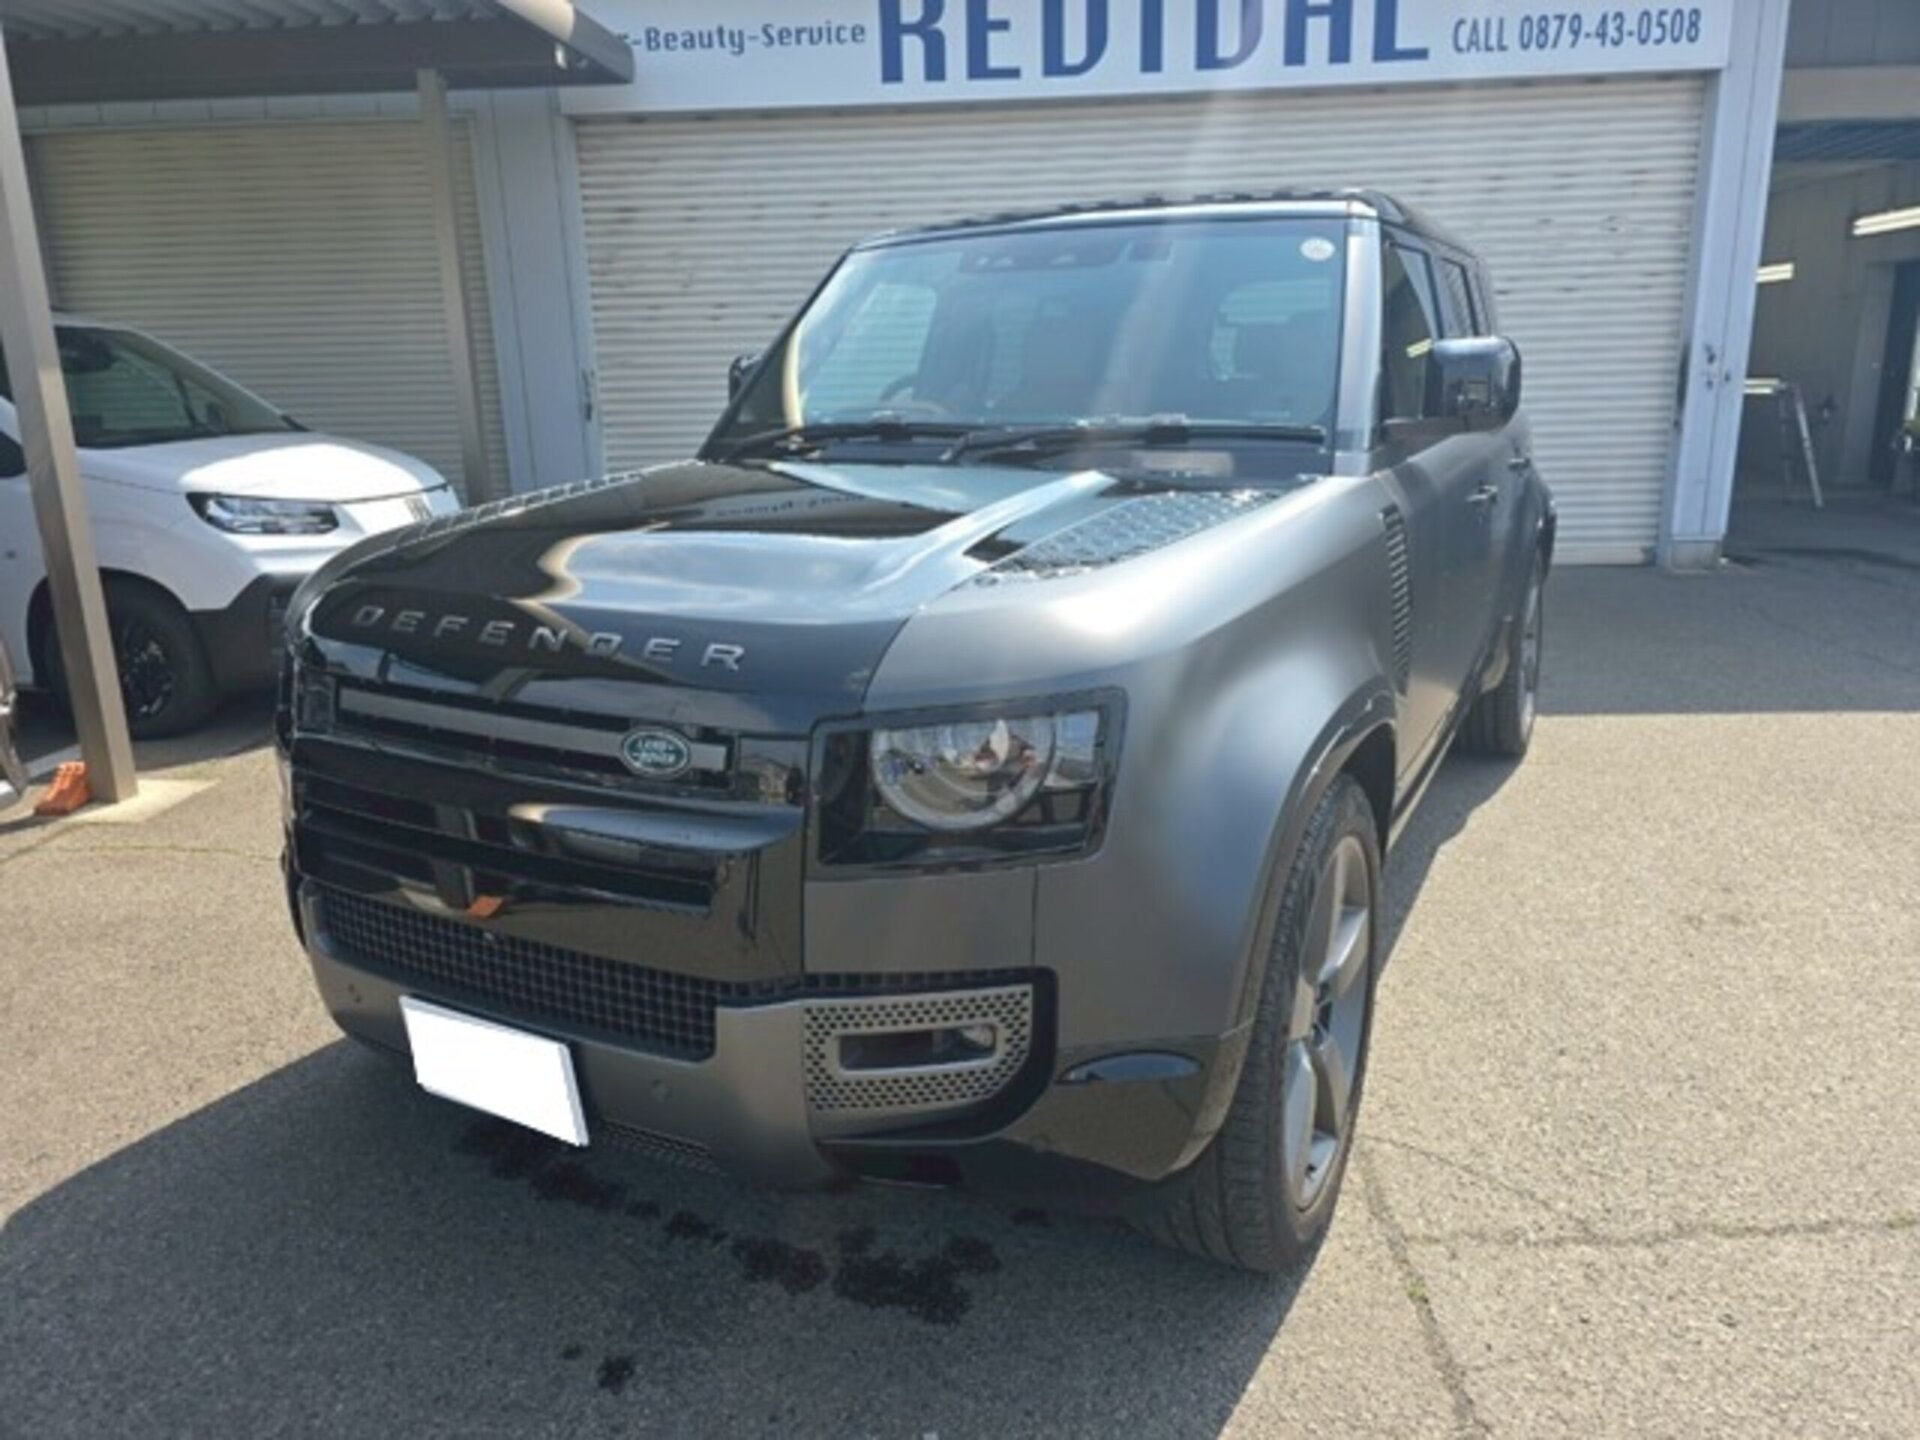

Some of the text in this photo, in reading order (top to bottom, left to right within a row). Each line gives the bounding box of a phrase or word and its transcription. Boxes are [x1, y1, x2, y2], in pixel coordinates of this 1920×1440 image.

[1453, 8, 1701, 53] CALL 0879-43-0508
[351, 605, 745, 670] DEFENDER
